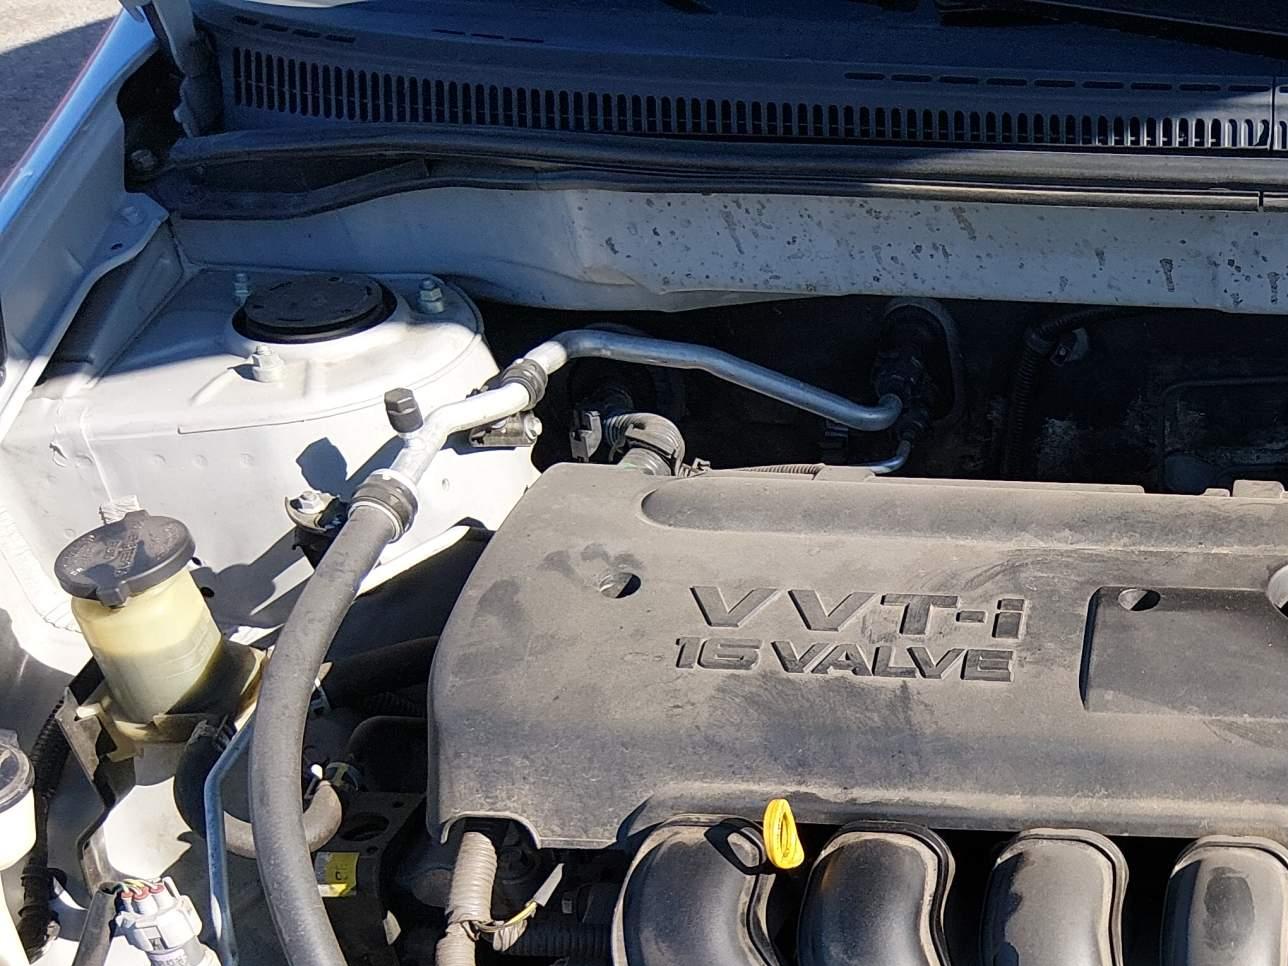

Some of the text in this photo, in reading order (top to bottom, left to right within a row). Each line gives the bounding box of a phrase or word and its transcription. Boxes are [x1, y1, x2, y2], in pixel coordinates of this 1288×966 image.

[689, 585, 1027, 641] VVT-i
[675, 637, 1015, 683] 16 VALVE
